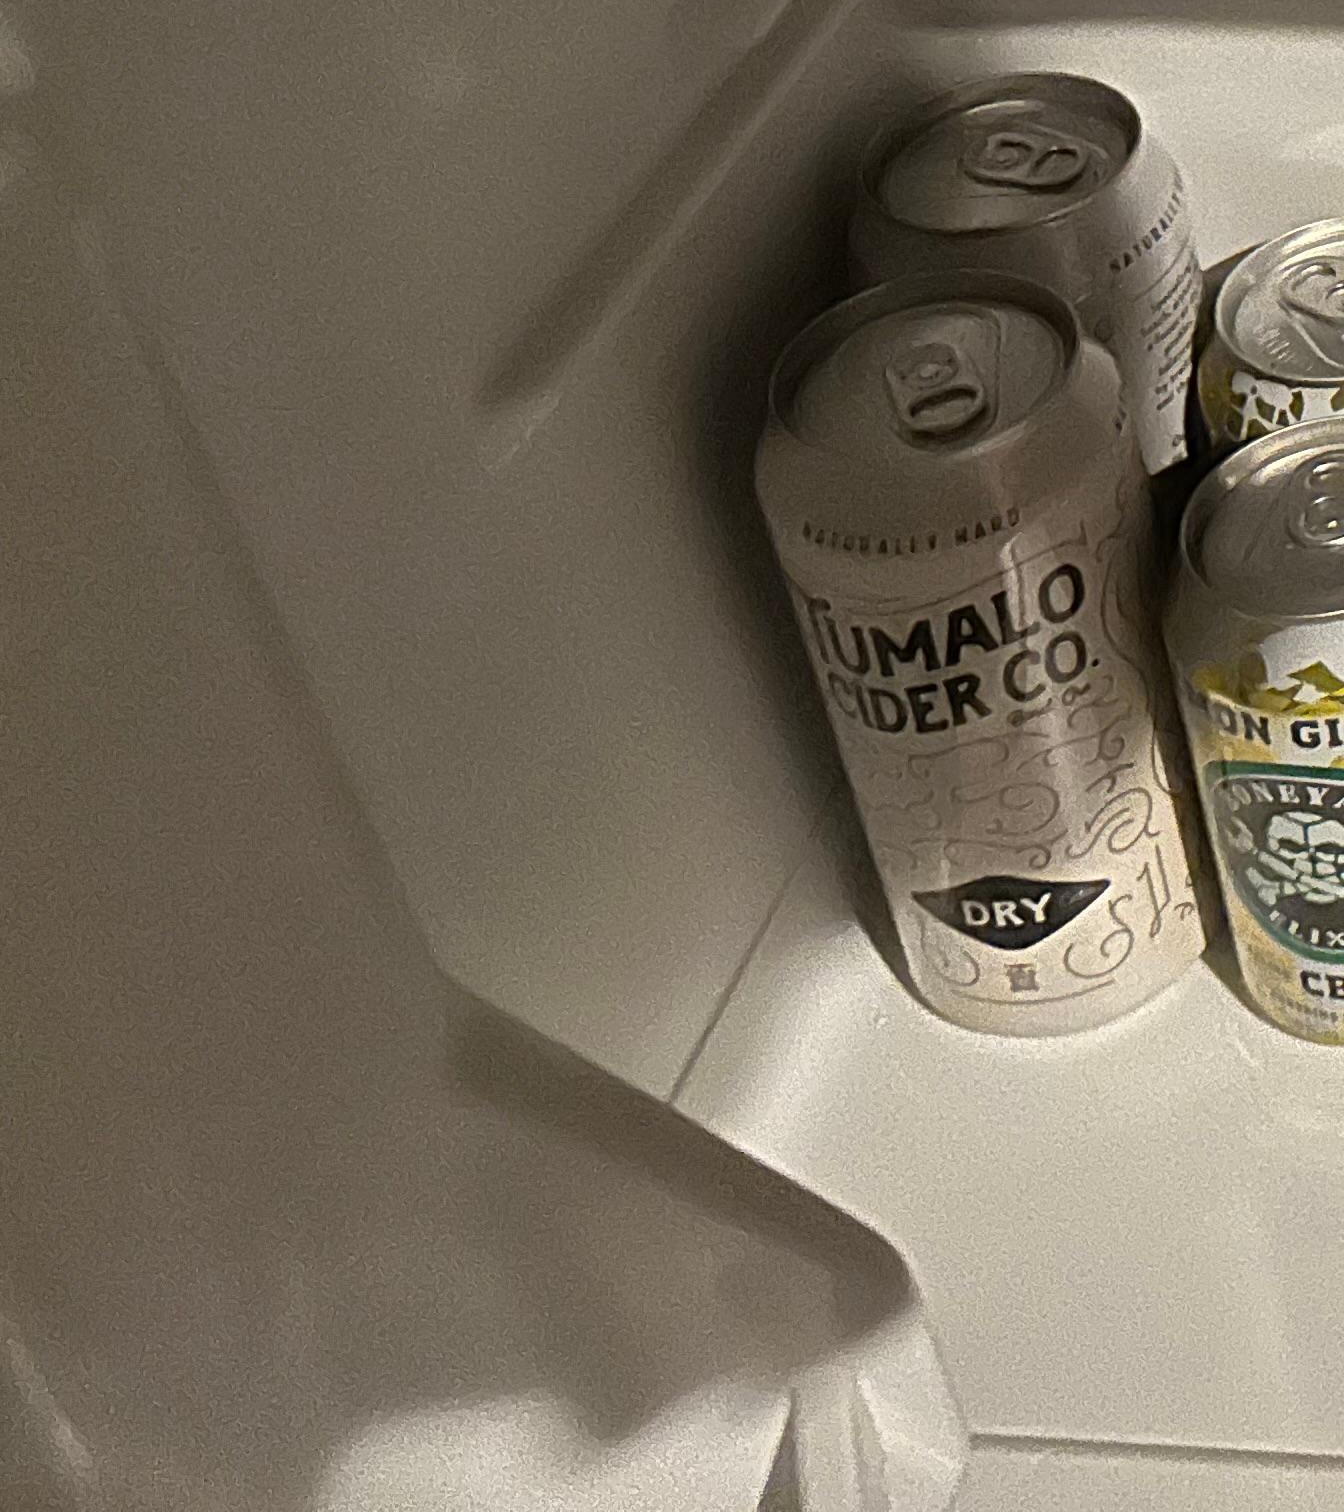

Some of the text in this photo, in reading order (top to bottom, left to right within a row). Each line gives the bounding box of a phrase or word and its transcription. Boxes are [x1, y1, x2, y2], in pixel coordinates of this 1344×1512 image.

[806, 563, 1086, 677] TUMALO
[827, 631, 1100, 734] CIDER CO.
[960, 891, 1053, 929] DRY
